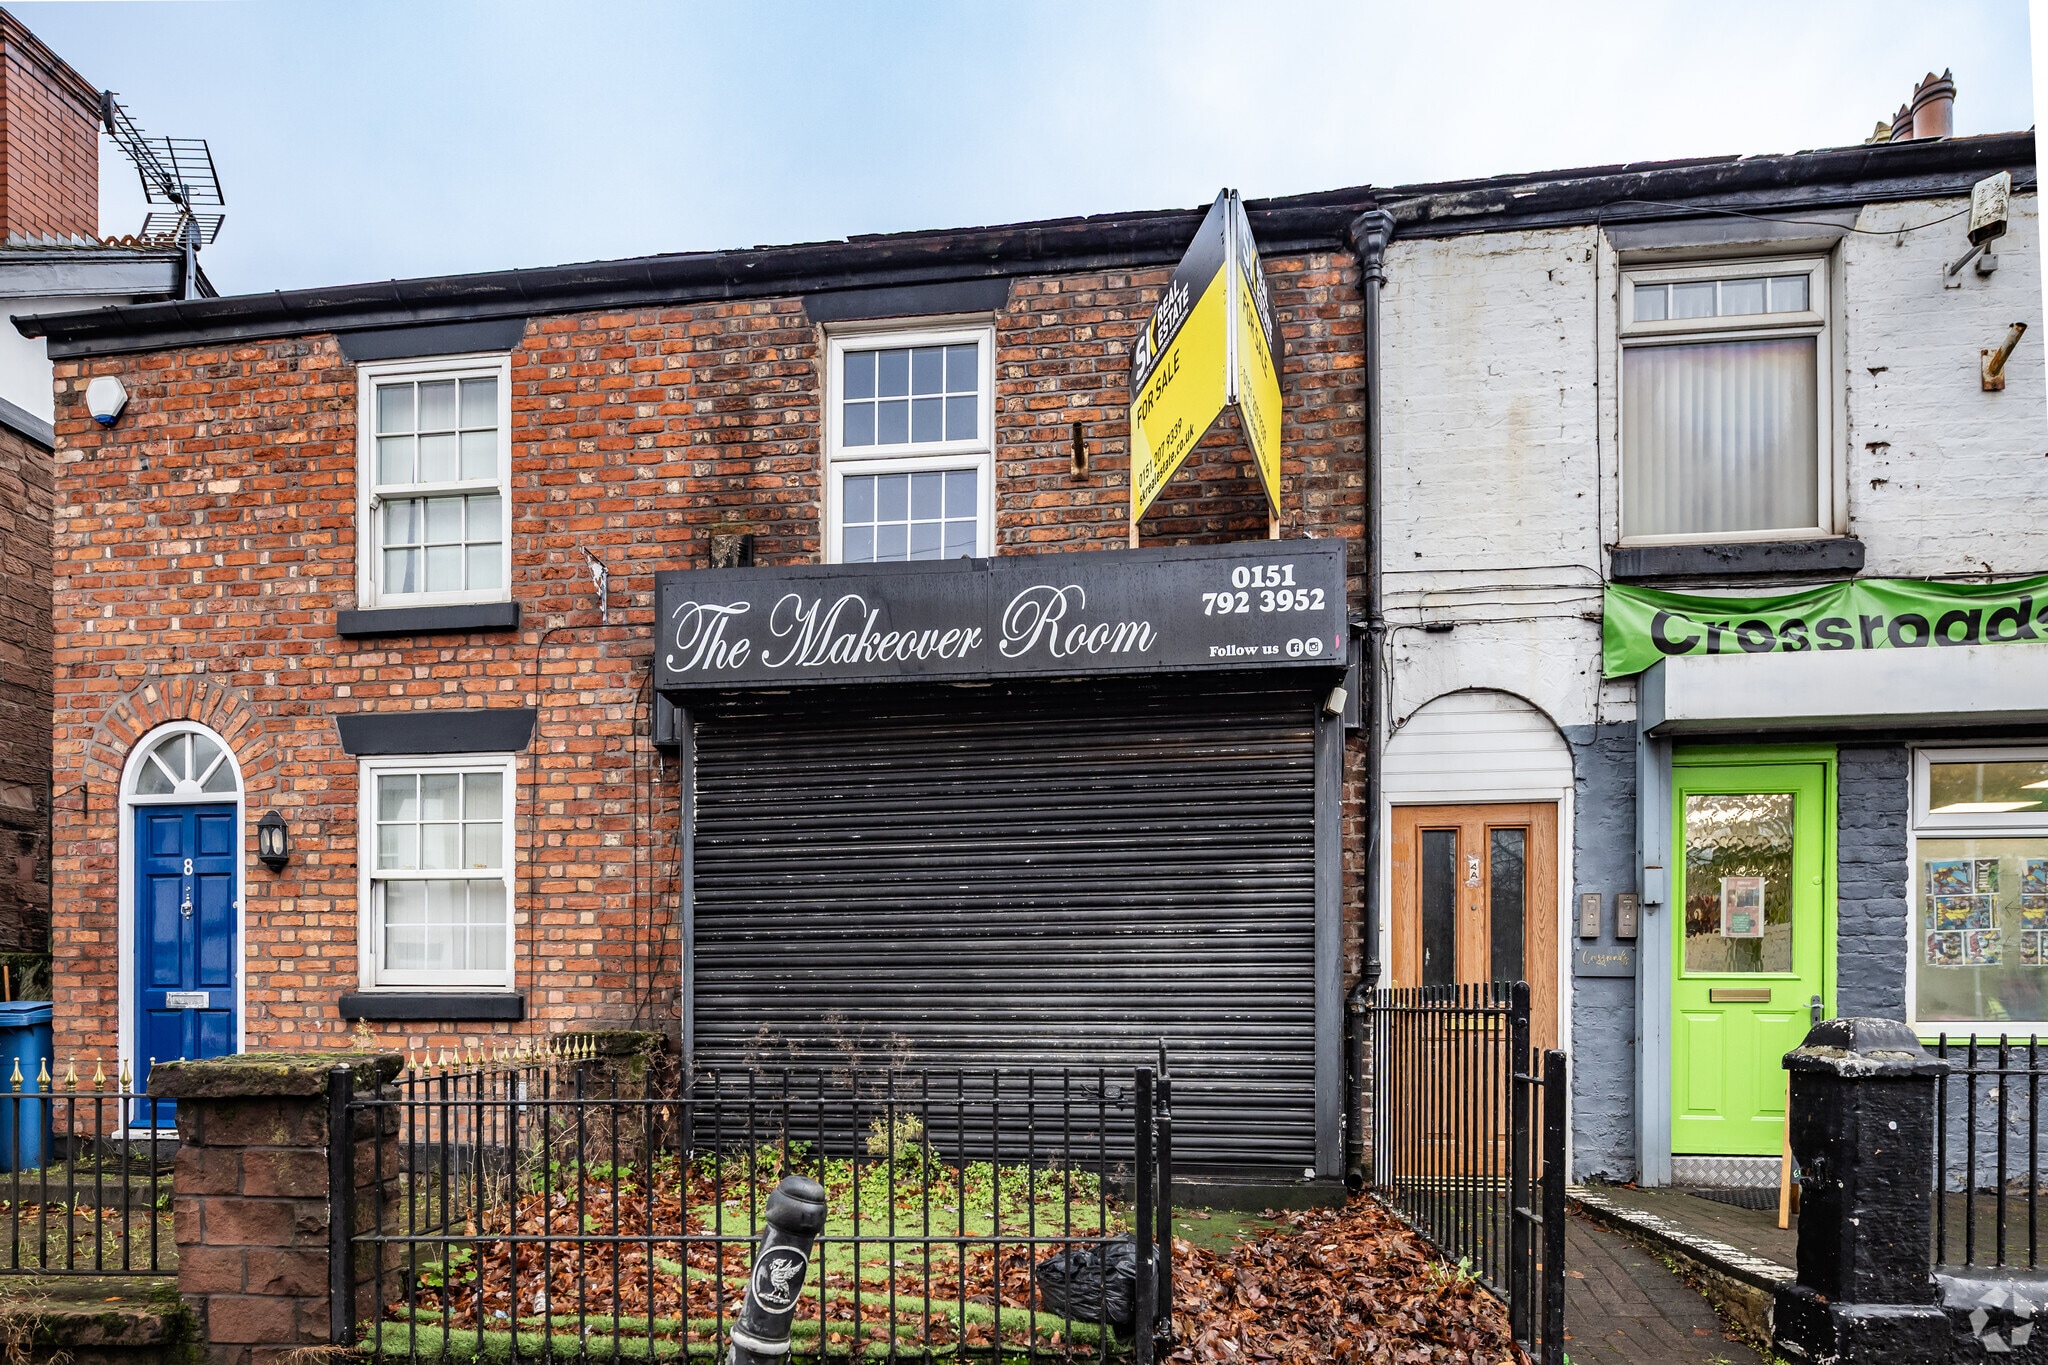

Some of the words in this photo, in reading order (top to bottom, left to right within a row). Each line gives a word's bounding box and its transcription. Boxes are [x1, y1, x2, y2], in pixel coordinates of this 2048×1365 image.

[1157, 279, 1180, 328] REAL
[1158, 282, 1189, 348] ESTATE
[1135, 313, 1158, 381] SK
[1137, 389, 1154, 430] FOR
[1156, 348, 1180, 401] SALE
[1138, 458, 1153, 488] 0151
[1153, 440, 1165, 468] 207
[1166, 417, 1182, 449] 9339
[1139, 423, 1194, 506] skrealestate.co.uk
[1201, 591, 1251, 617] 792
[1259, 587, 1326, 613] 3952
[1231, 564, 1297, 589] 0151
[665, 600, 751, 673] The
[761, 592, 983, 669] Makeover
[998, 584, 1158, 659] Room
[1209, 644, 1259, 658] Follow
[1262, 644, 1279, 656] us
[183, 858, 194, 876] 8
